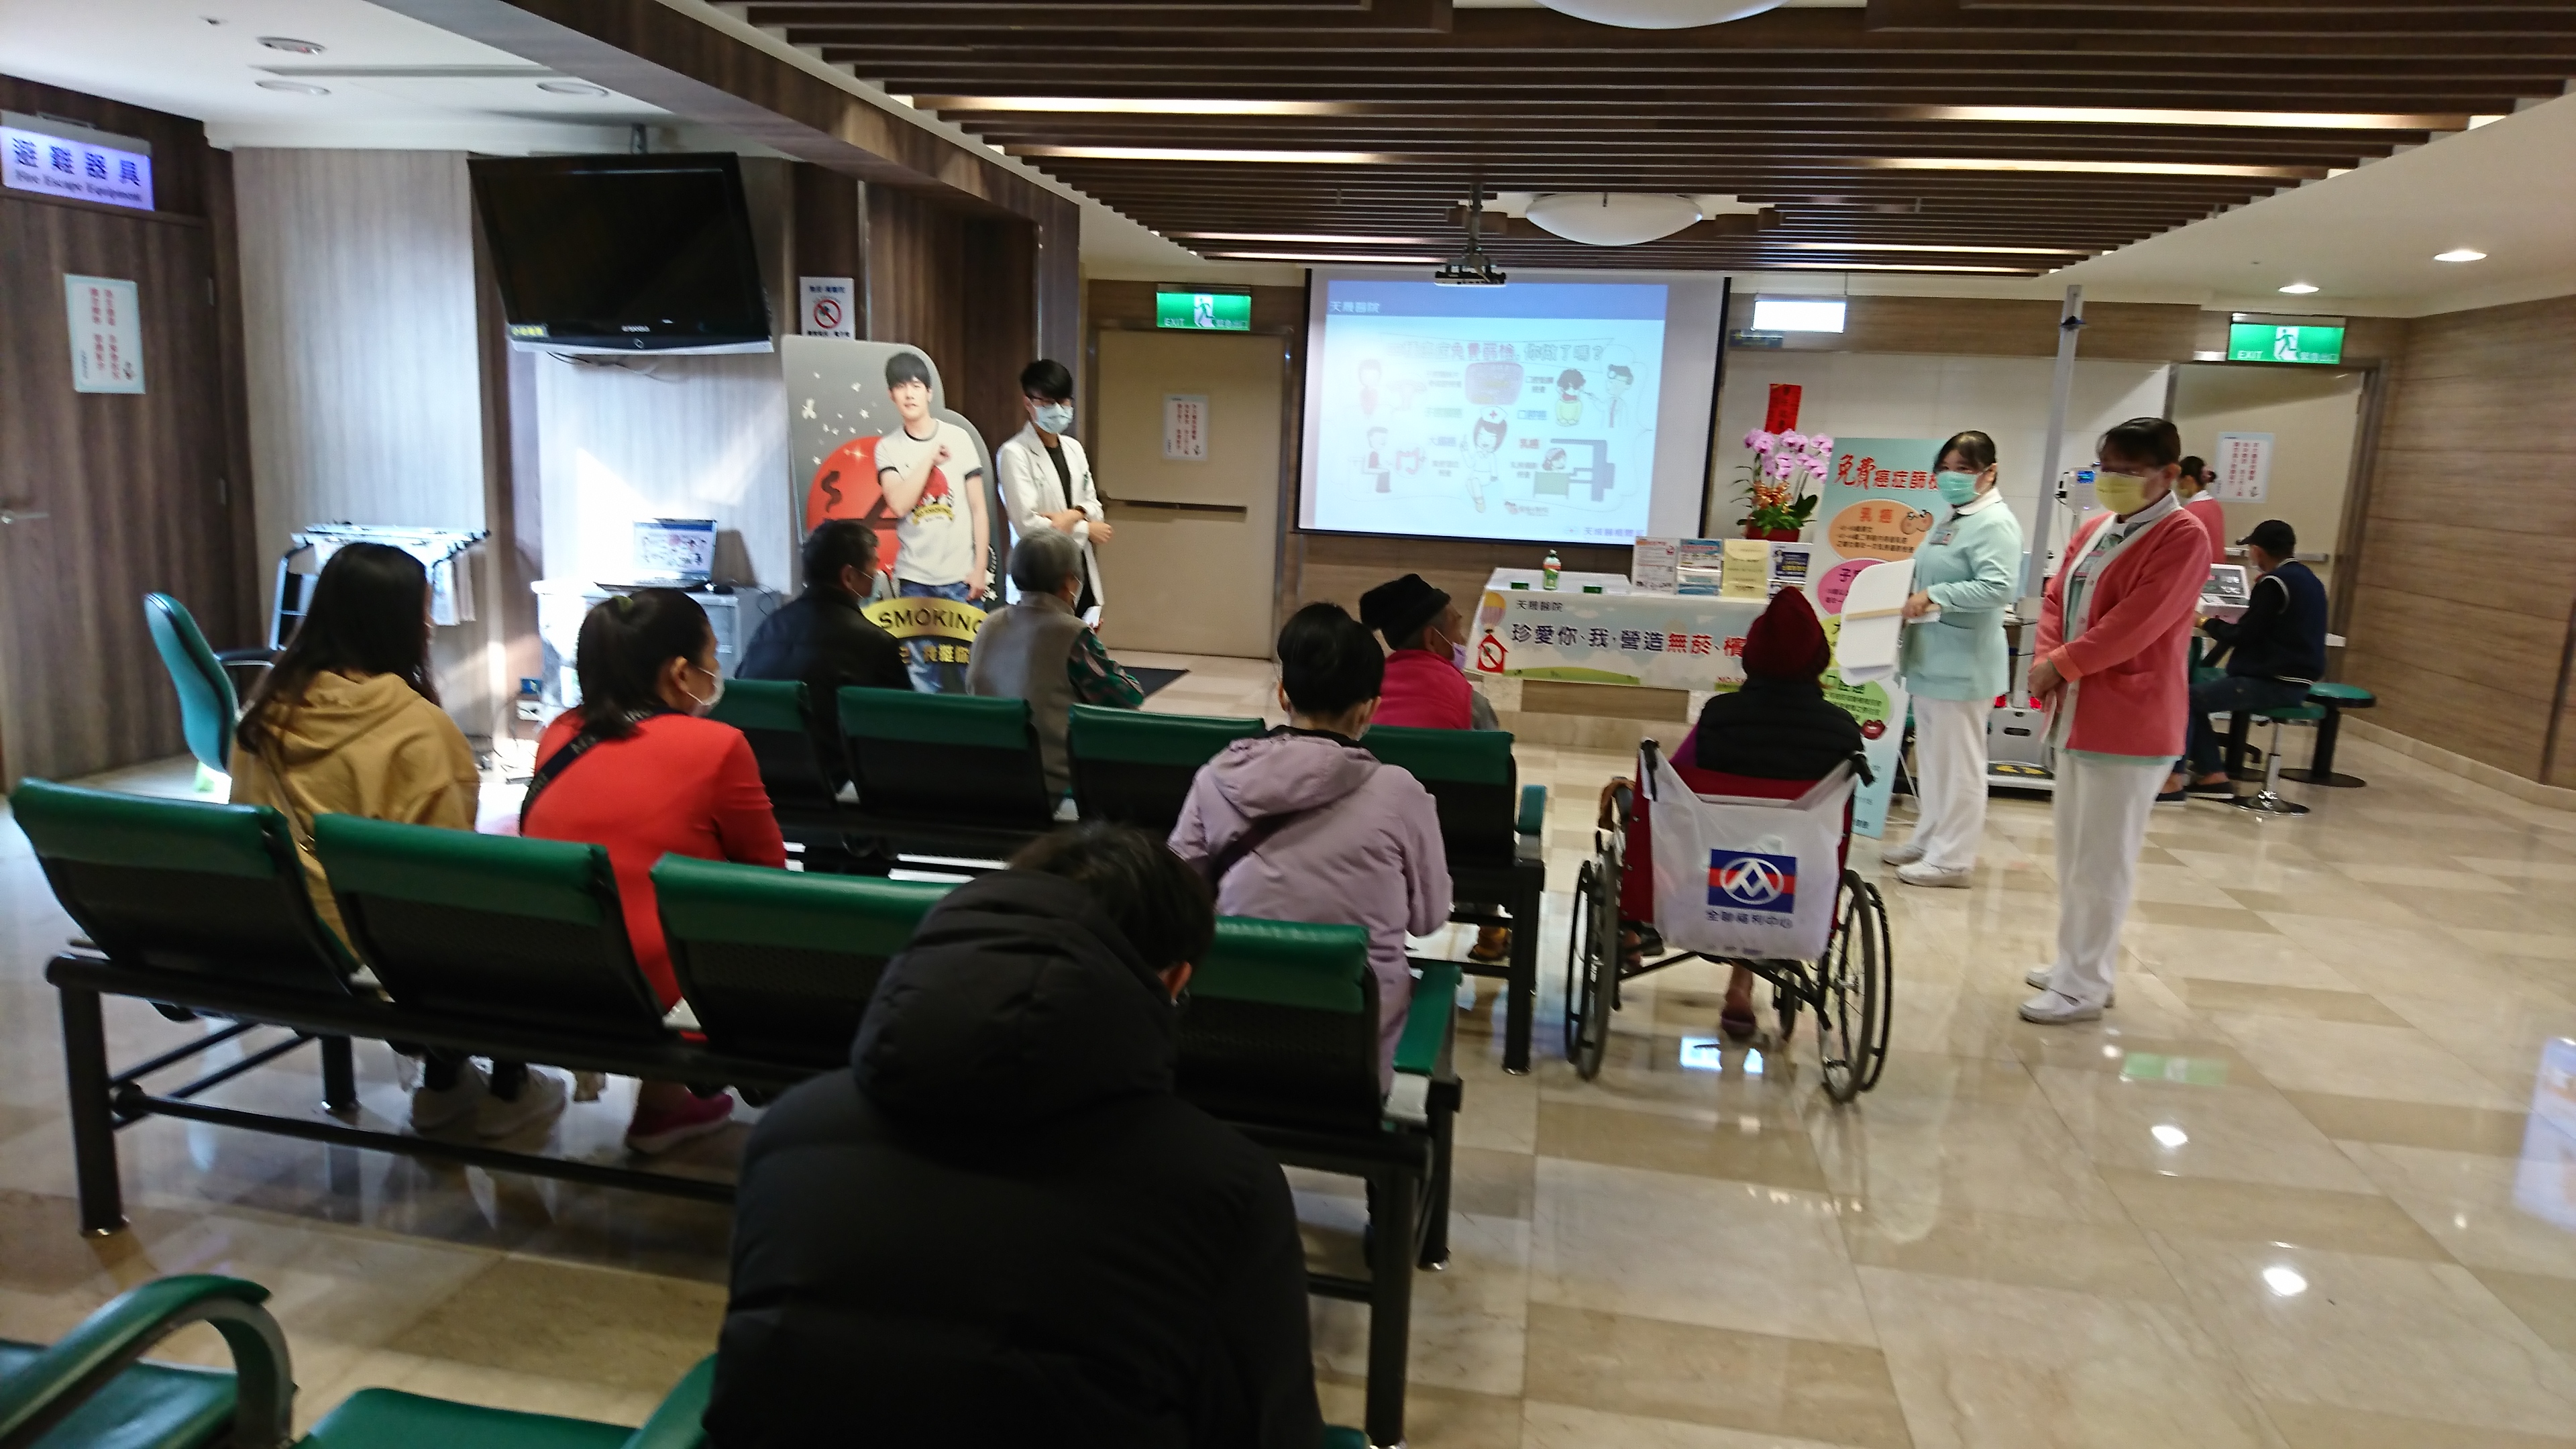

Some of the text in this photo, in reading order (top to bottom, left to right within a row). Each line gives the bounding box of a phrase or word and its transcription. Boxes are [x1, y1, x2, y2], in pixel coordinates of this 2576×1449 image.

[1164, 317, 1185, 327] EXIT
[2237, 350, 2263, 359] EXIT
[1706, 910, 1793, 929] 全聯福利中心
